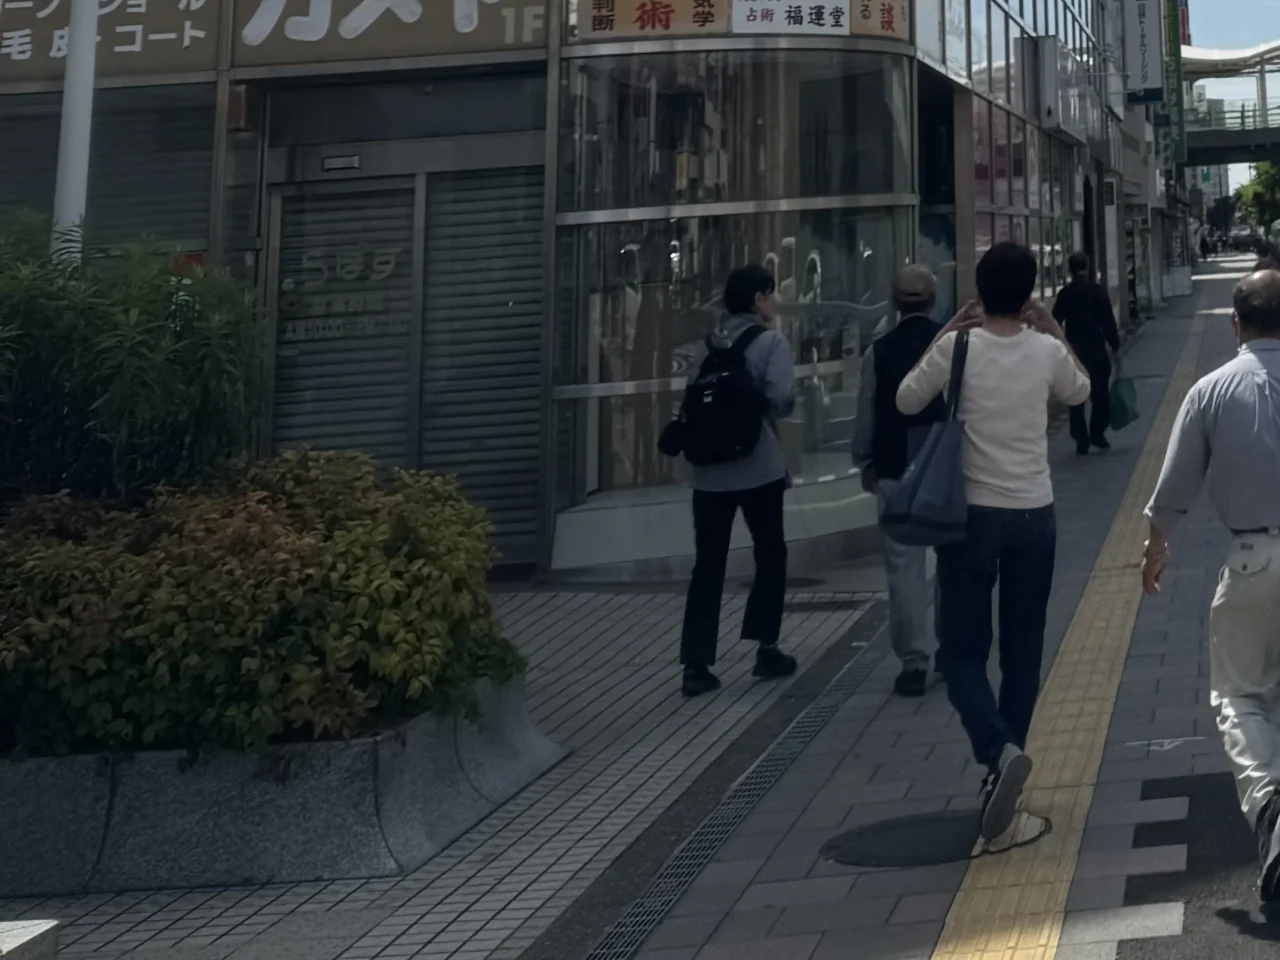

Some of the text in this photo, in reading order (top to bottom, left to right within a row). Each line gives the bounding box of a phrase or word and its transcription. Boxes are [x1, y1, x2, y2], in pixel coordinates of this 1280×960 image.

[500, 5, 545, 45] 1F
[784, 4, 846, 28] 福運堂
[113, 20, 207, 53] コート
